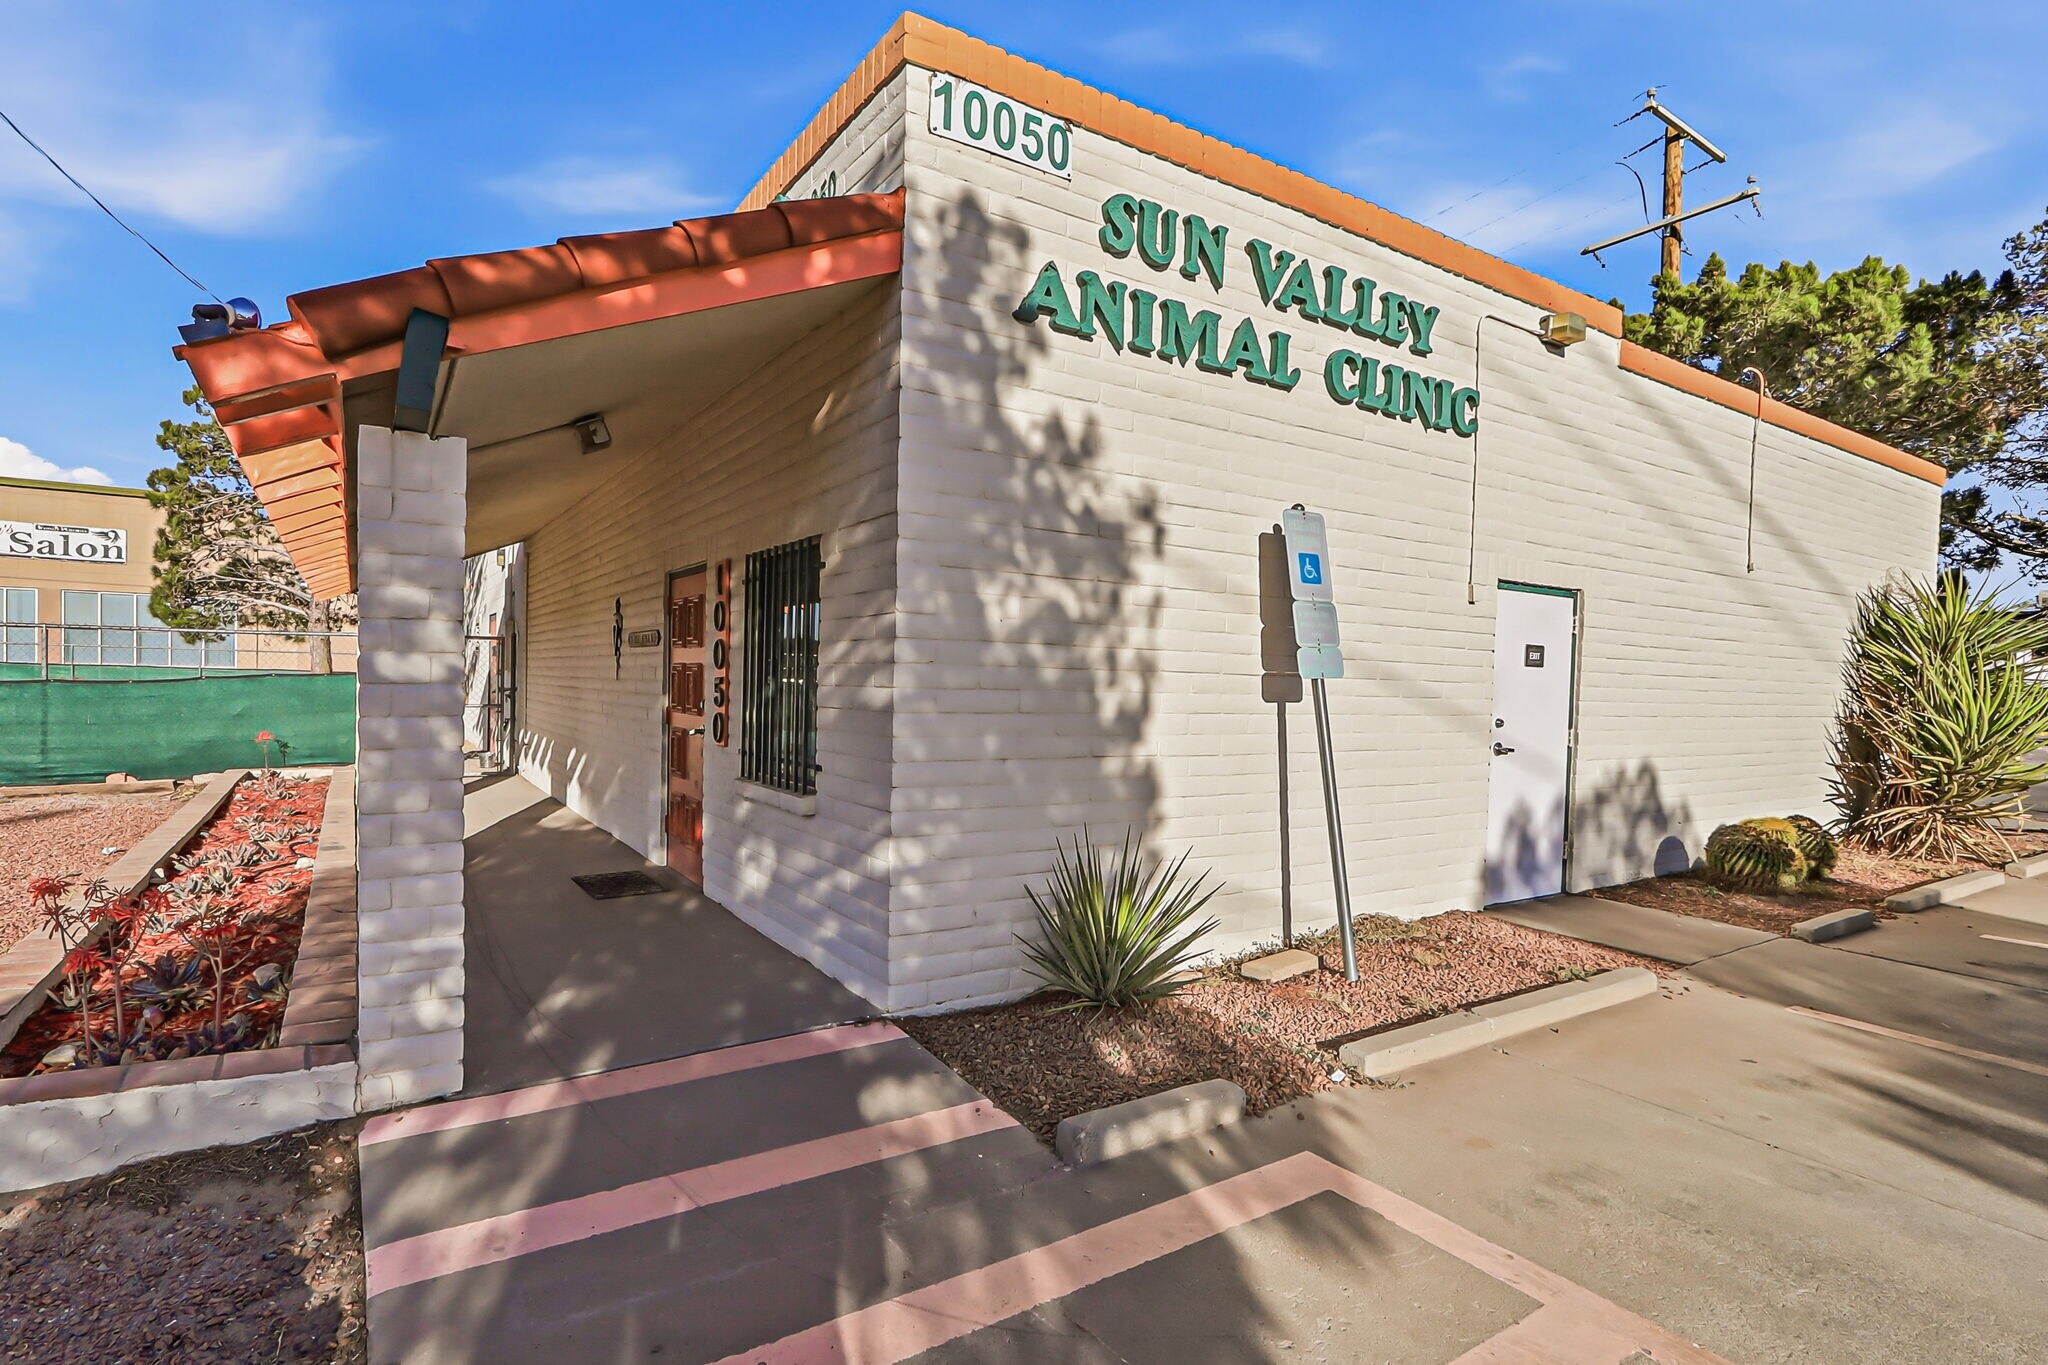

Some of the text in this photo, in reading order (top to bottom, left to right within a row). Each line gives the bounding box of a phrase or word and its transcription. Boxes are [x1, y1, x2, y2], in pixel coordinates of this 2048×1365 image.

[934, 81, 1069, 170] 10050
[1012, 260, 1479, 437] ANIMAL CLINIC
[1099, 193, 1440, 356] SUN VALLEY
[9, 531, 125, 560] Salon
[712, 564, 726, 743] 10050
